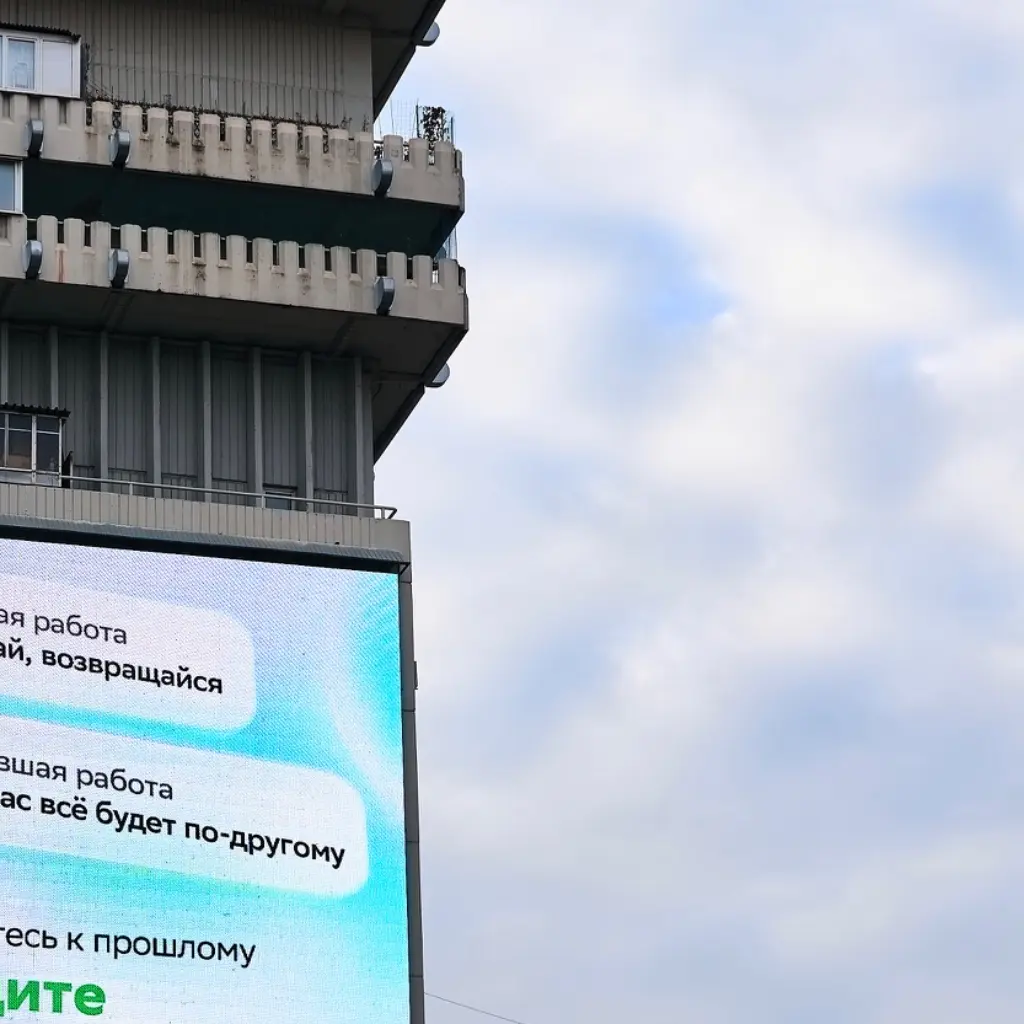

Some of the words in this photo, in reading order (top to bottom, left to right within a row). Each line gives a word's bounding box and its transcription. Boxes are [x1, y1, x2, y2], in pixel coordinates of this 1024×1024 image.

[33, 614, 128, 646] работа
[41, 648, 223, 694] возвращайся
[76, 766, 174, 802] работа
[40, 799, 89, 823] всё
[95, 799, 177, 839] будет
[184, 822, 345, 869] по-другому
[66, 930, 85, 952] к
[93, 932, 257, 970] прошлому
